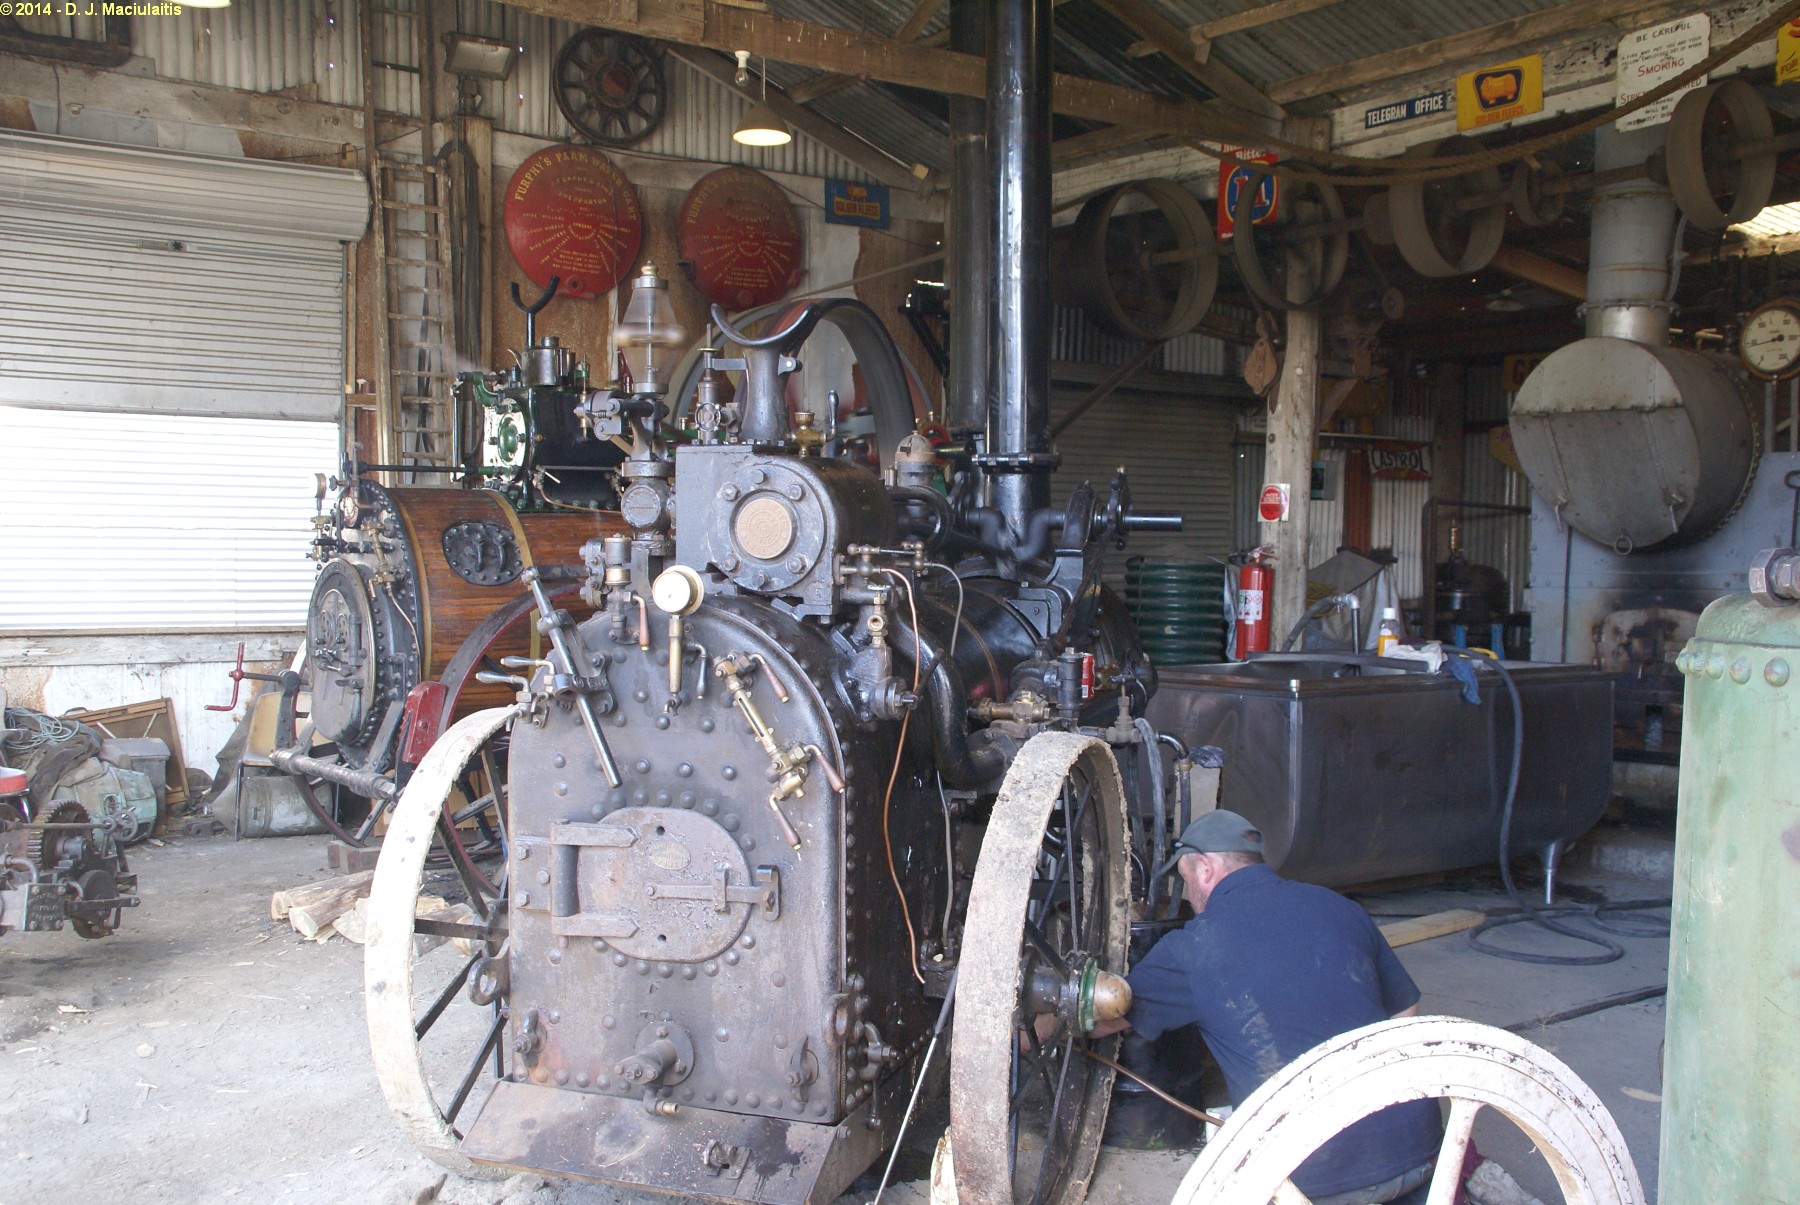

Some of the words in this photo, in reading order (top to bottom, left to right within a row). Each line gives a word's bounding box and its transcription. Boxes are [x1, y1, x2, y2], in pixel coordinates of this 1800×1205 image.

[1636, 34, 1648, 43] BE
[1652, 22, 1692, 38] CAREFUL
[1638, 59, 1685, 77] SMOKING
[1367, 105, 1407, 125] TELEGRAM
[1415, 95, 1443, 114] OFFICE
[514, 156, 552, 202] FURPHY'S
[555, 151, 588, 163] FARM
[623, 191, 637, 221] CART
[1370, 449, 1429, 474] CASTROL
